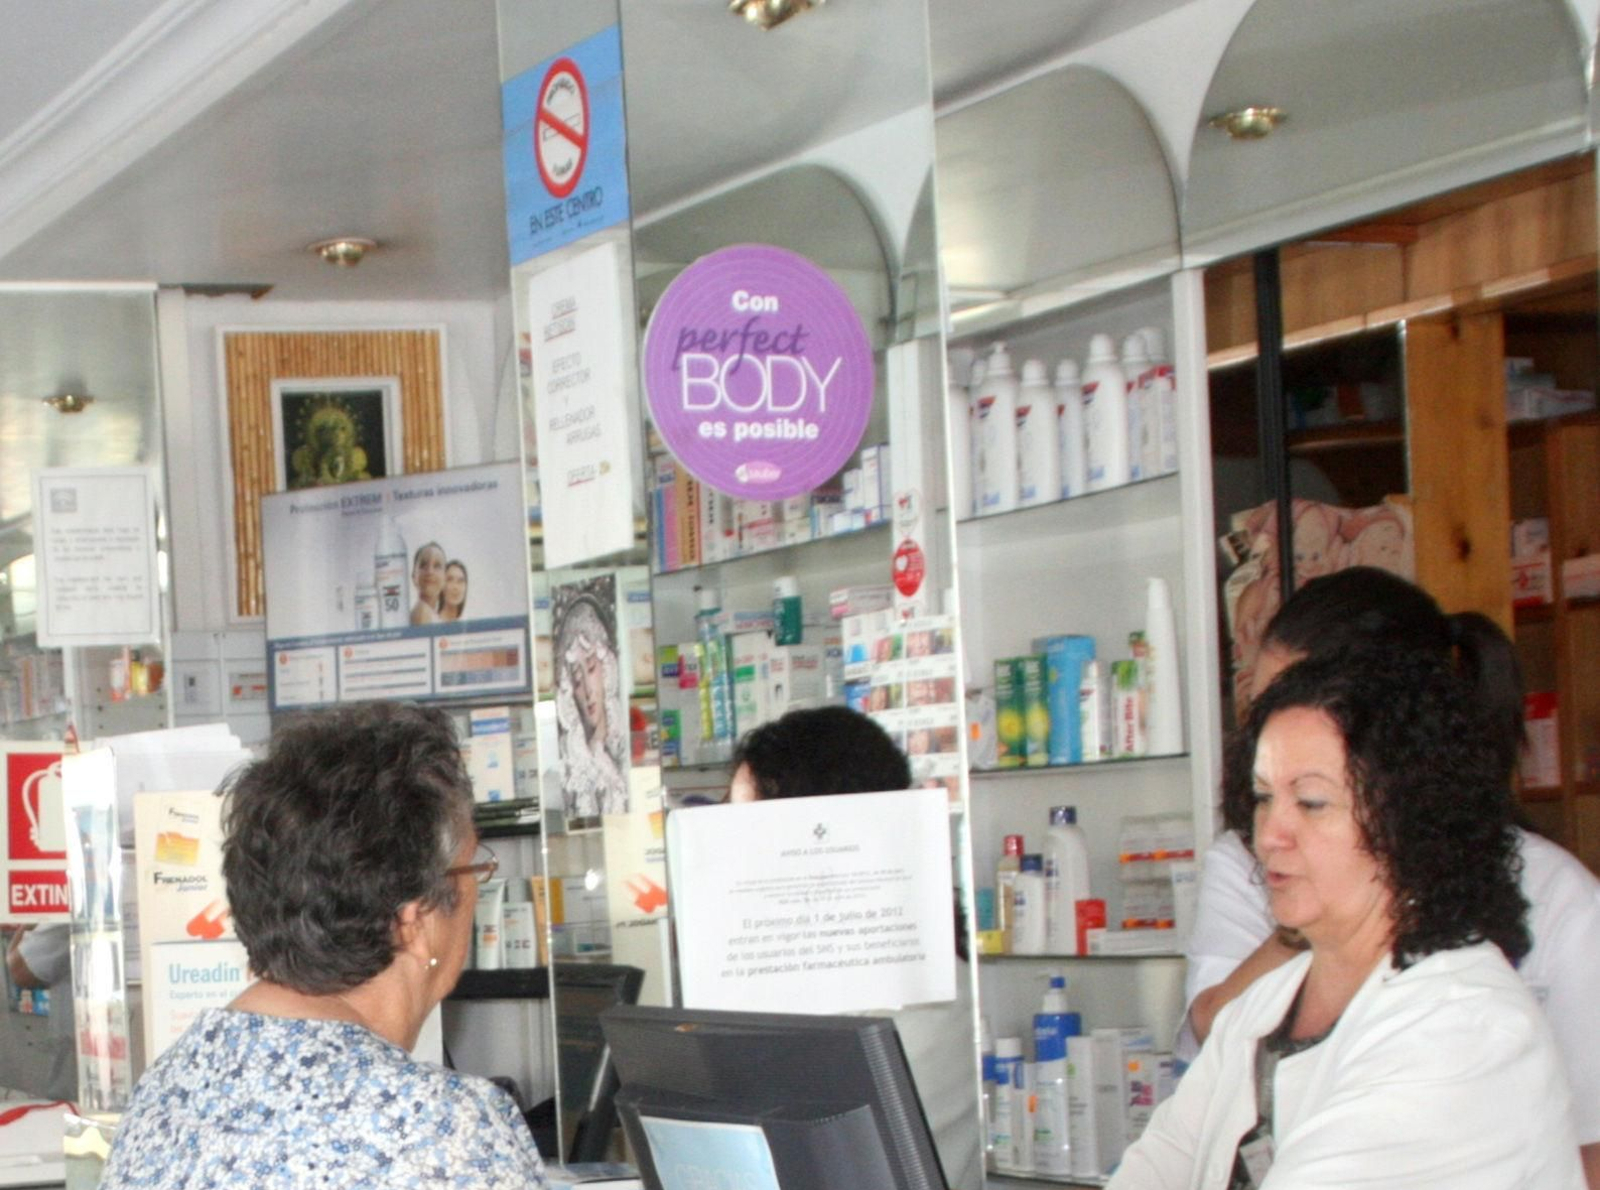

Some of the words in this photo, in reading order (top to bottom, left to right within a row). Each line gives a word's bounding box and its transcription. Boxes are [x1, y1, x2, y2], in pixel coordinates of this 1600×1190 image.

[530, 215, 543, 235] EN
[544, 202, 564, 229] ESTE
[566, 186, 604, 219] CENTRO
[731, 289, 779, 312] Con
[672, 316, 810, 375] perfect
[681, 352, 843, 413] BODY
[698, 420, 728, 438] es
[733, 418, 820, 442] posible
[341, 492, 383, 508] EXTREM
[393, 488, 434, 501] Texturas
[437, 480, 499, 496] innovadoras
[11, 884, 68, 906] EXTIN
[743, 918, 752, 930] El
[824, 912, 835, 923] de
[865, 909, 877, 920] de
[881, 906, 904, 918] 2012
[728, 933, 759, 946] entran
[762, 933, 774, 944] en
[777, 930, 801, 944] vigor
[819, 926, 855, 939] nuevas
[858, 921, 918, 939] aportaciones
[726, 951, 738, 962] de
[741, 950, 755, 961] los
[757, 947, 796, 960] usuarios
[798, 944, 814, 956] del
[846, 941, 861, 952] sus
[168, 961, 241, 984] Ureadin
[721, 968, 733, 978] en
[736, 966, 745, 977] la
[748, 960, 800, 978] prestación
